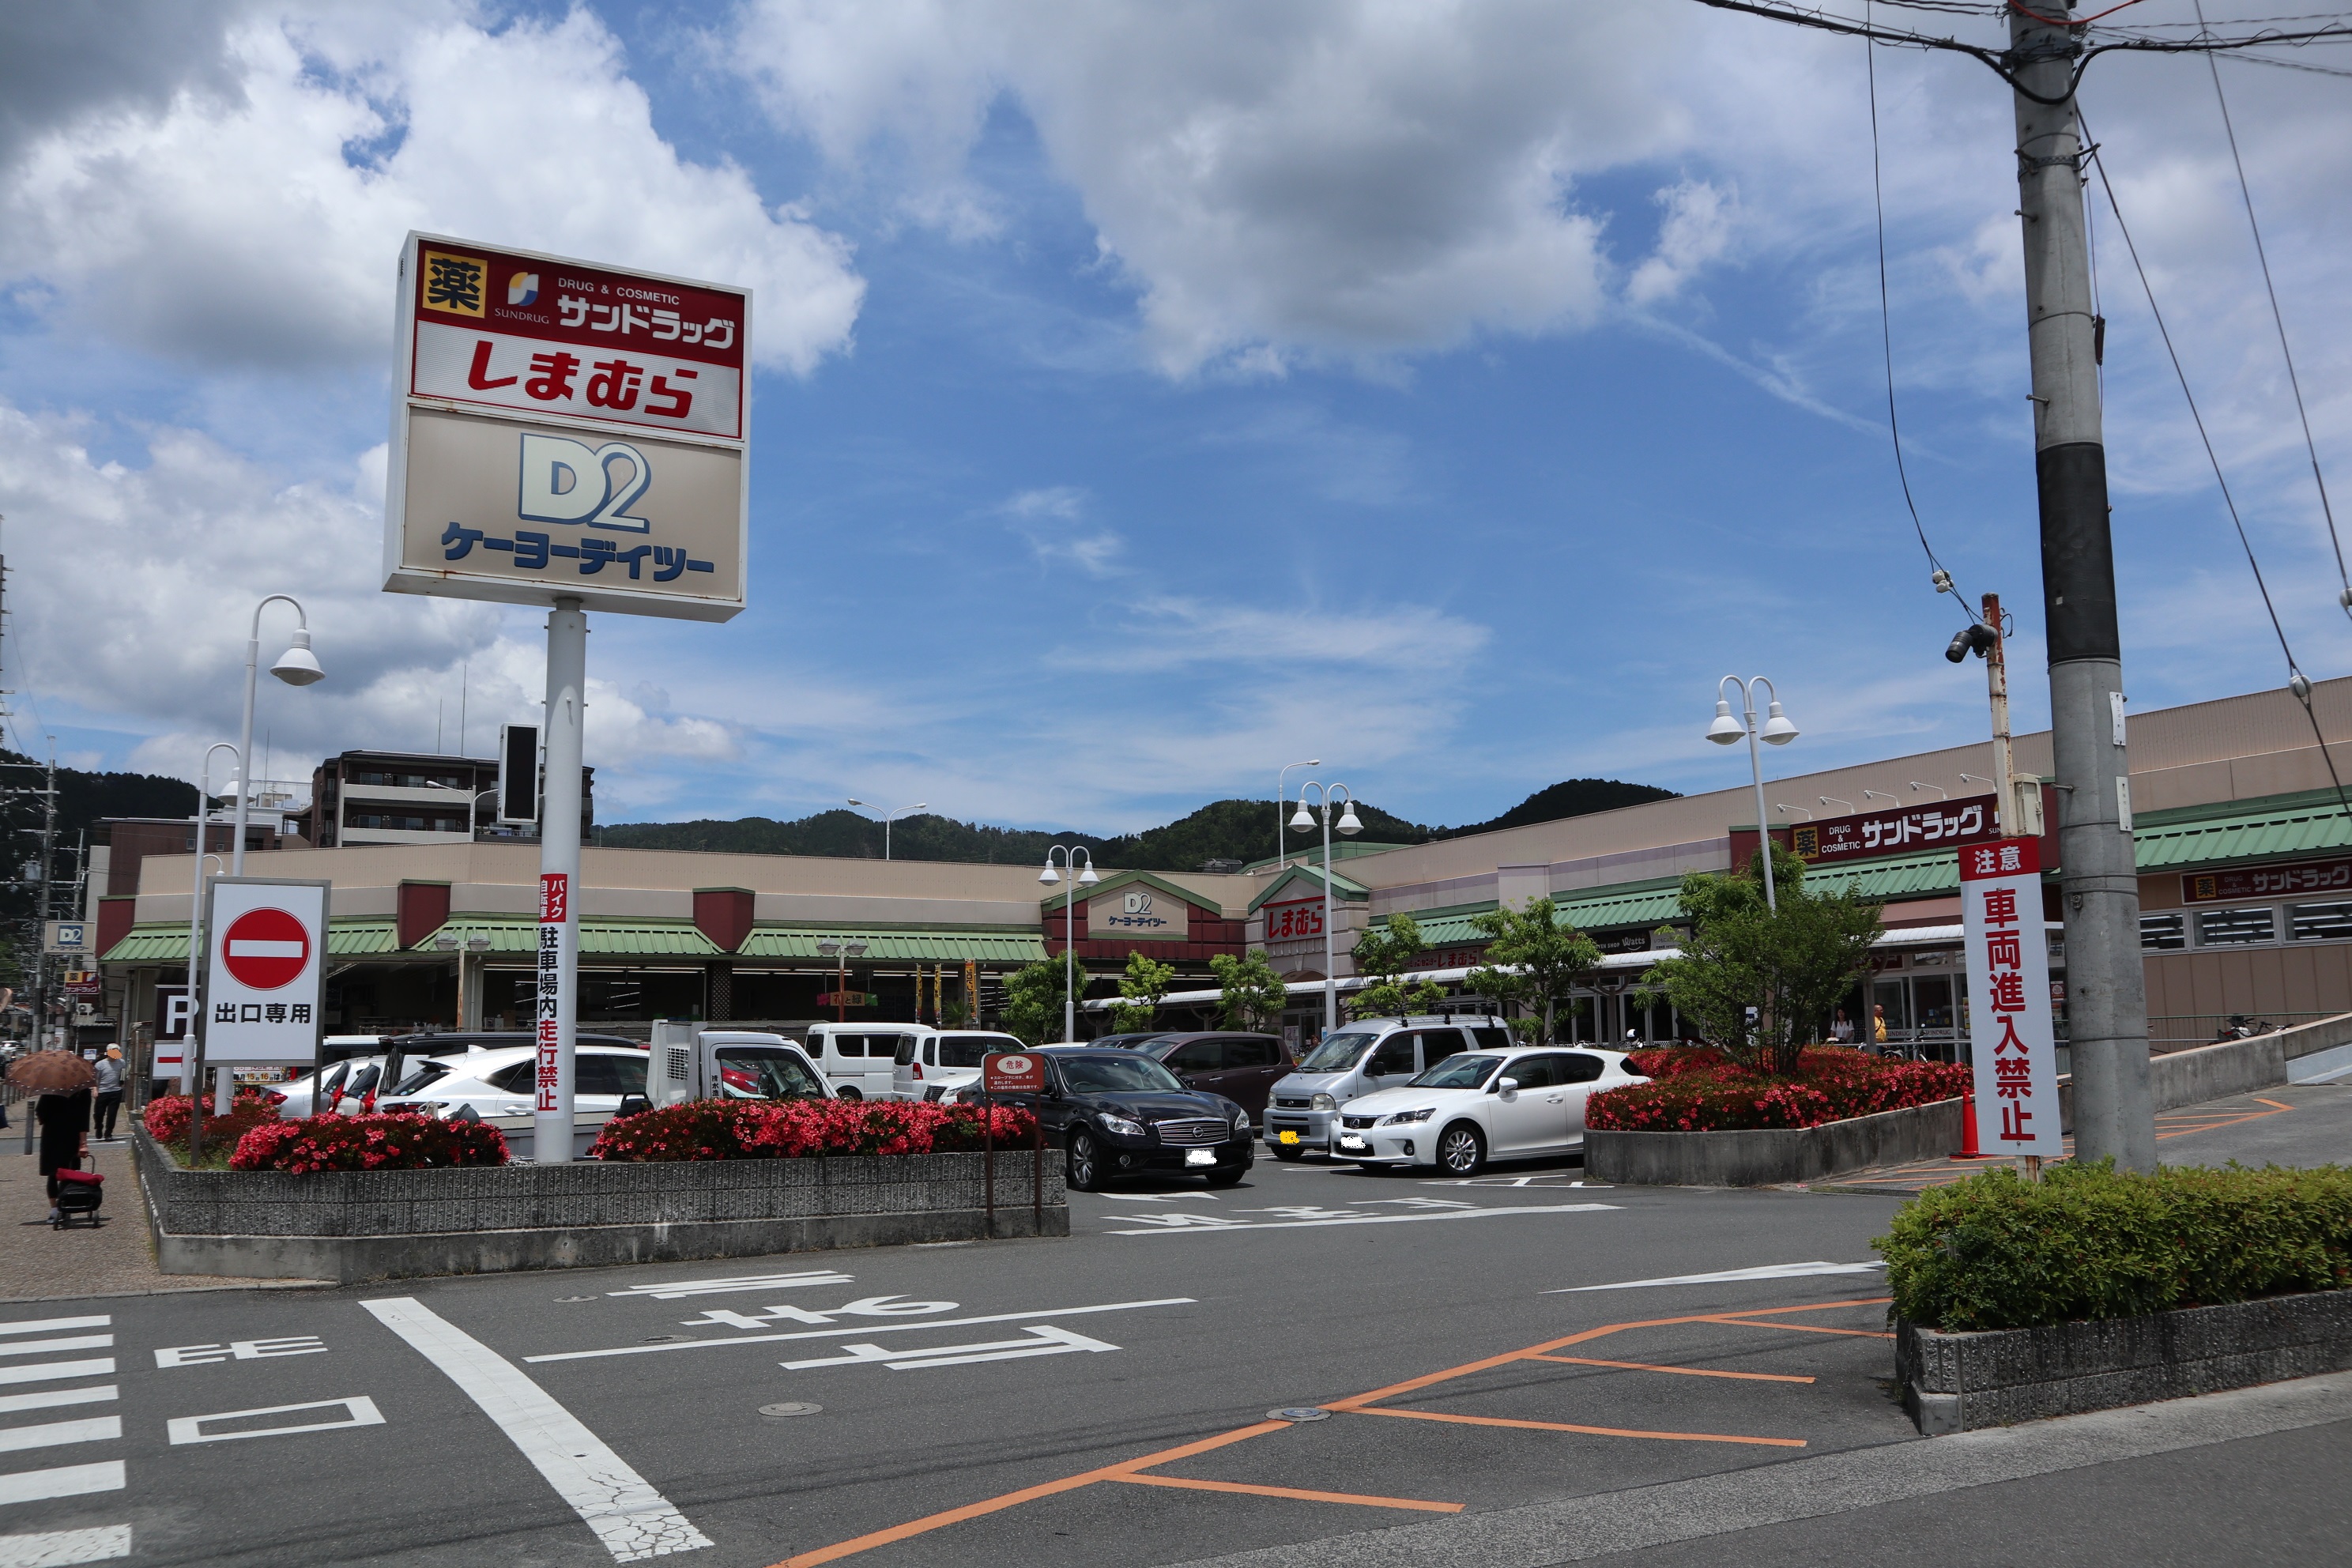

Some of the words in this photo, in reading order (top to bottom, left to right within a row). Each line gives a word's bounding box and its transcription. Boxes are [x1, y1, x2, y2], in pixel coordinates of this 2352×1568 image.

[427, 258, 480, 311] 薬
[558, 277, 594, 292] DRUG
[601, 285, 609, 294] &
[616, 287, 680, 305] COSMETIC
[495, 307, 549, 324] SUNDRUG
[557, 295, 735, 350] サンドラッグ
[468, 340, 698, 418] しまむら
[518, 432, 651, 533] D2
[442, 522, 714, 582] ケーヨーデイツー
[1829, 825, 1851, 835] DRUG
[1862, 805, 1983, 848] サンドラッグ
[1796, 830, 1817, 856] 薬
[1822, 841, 1860, 854] COSMETIC
[1975, 846, 2022, 874] 注意
[2198, 878, 2213, 896] 薬
[2253, 865, 2350, 891] サンドラッグ
[539, 879, 548, 919] 自転車
[551, 880, 565, 918] バイク
[1124, 892, 1152, 914] D2
[59, 929, 81, 942] D2
[1268, 905, 1323, 939] しまむら
[1622, 937, 1645, 948] Watts
[1438, 951, 1477, 967] しまむら
[166, 996, 199, 1033] P
[215, 1003, 311, 1023] 出口専用
[537, 926, 559, 1112] 駐車場内走行禁止
[1983, 888, 2036, 1140] 車両進入禁止
[1006, 1060, 1023, 1069] 危険
